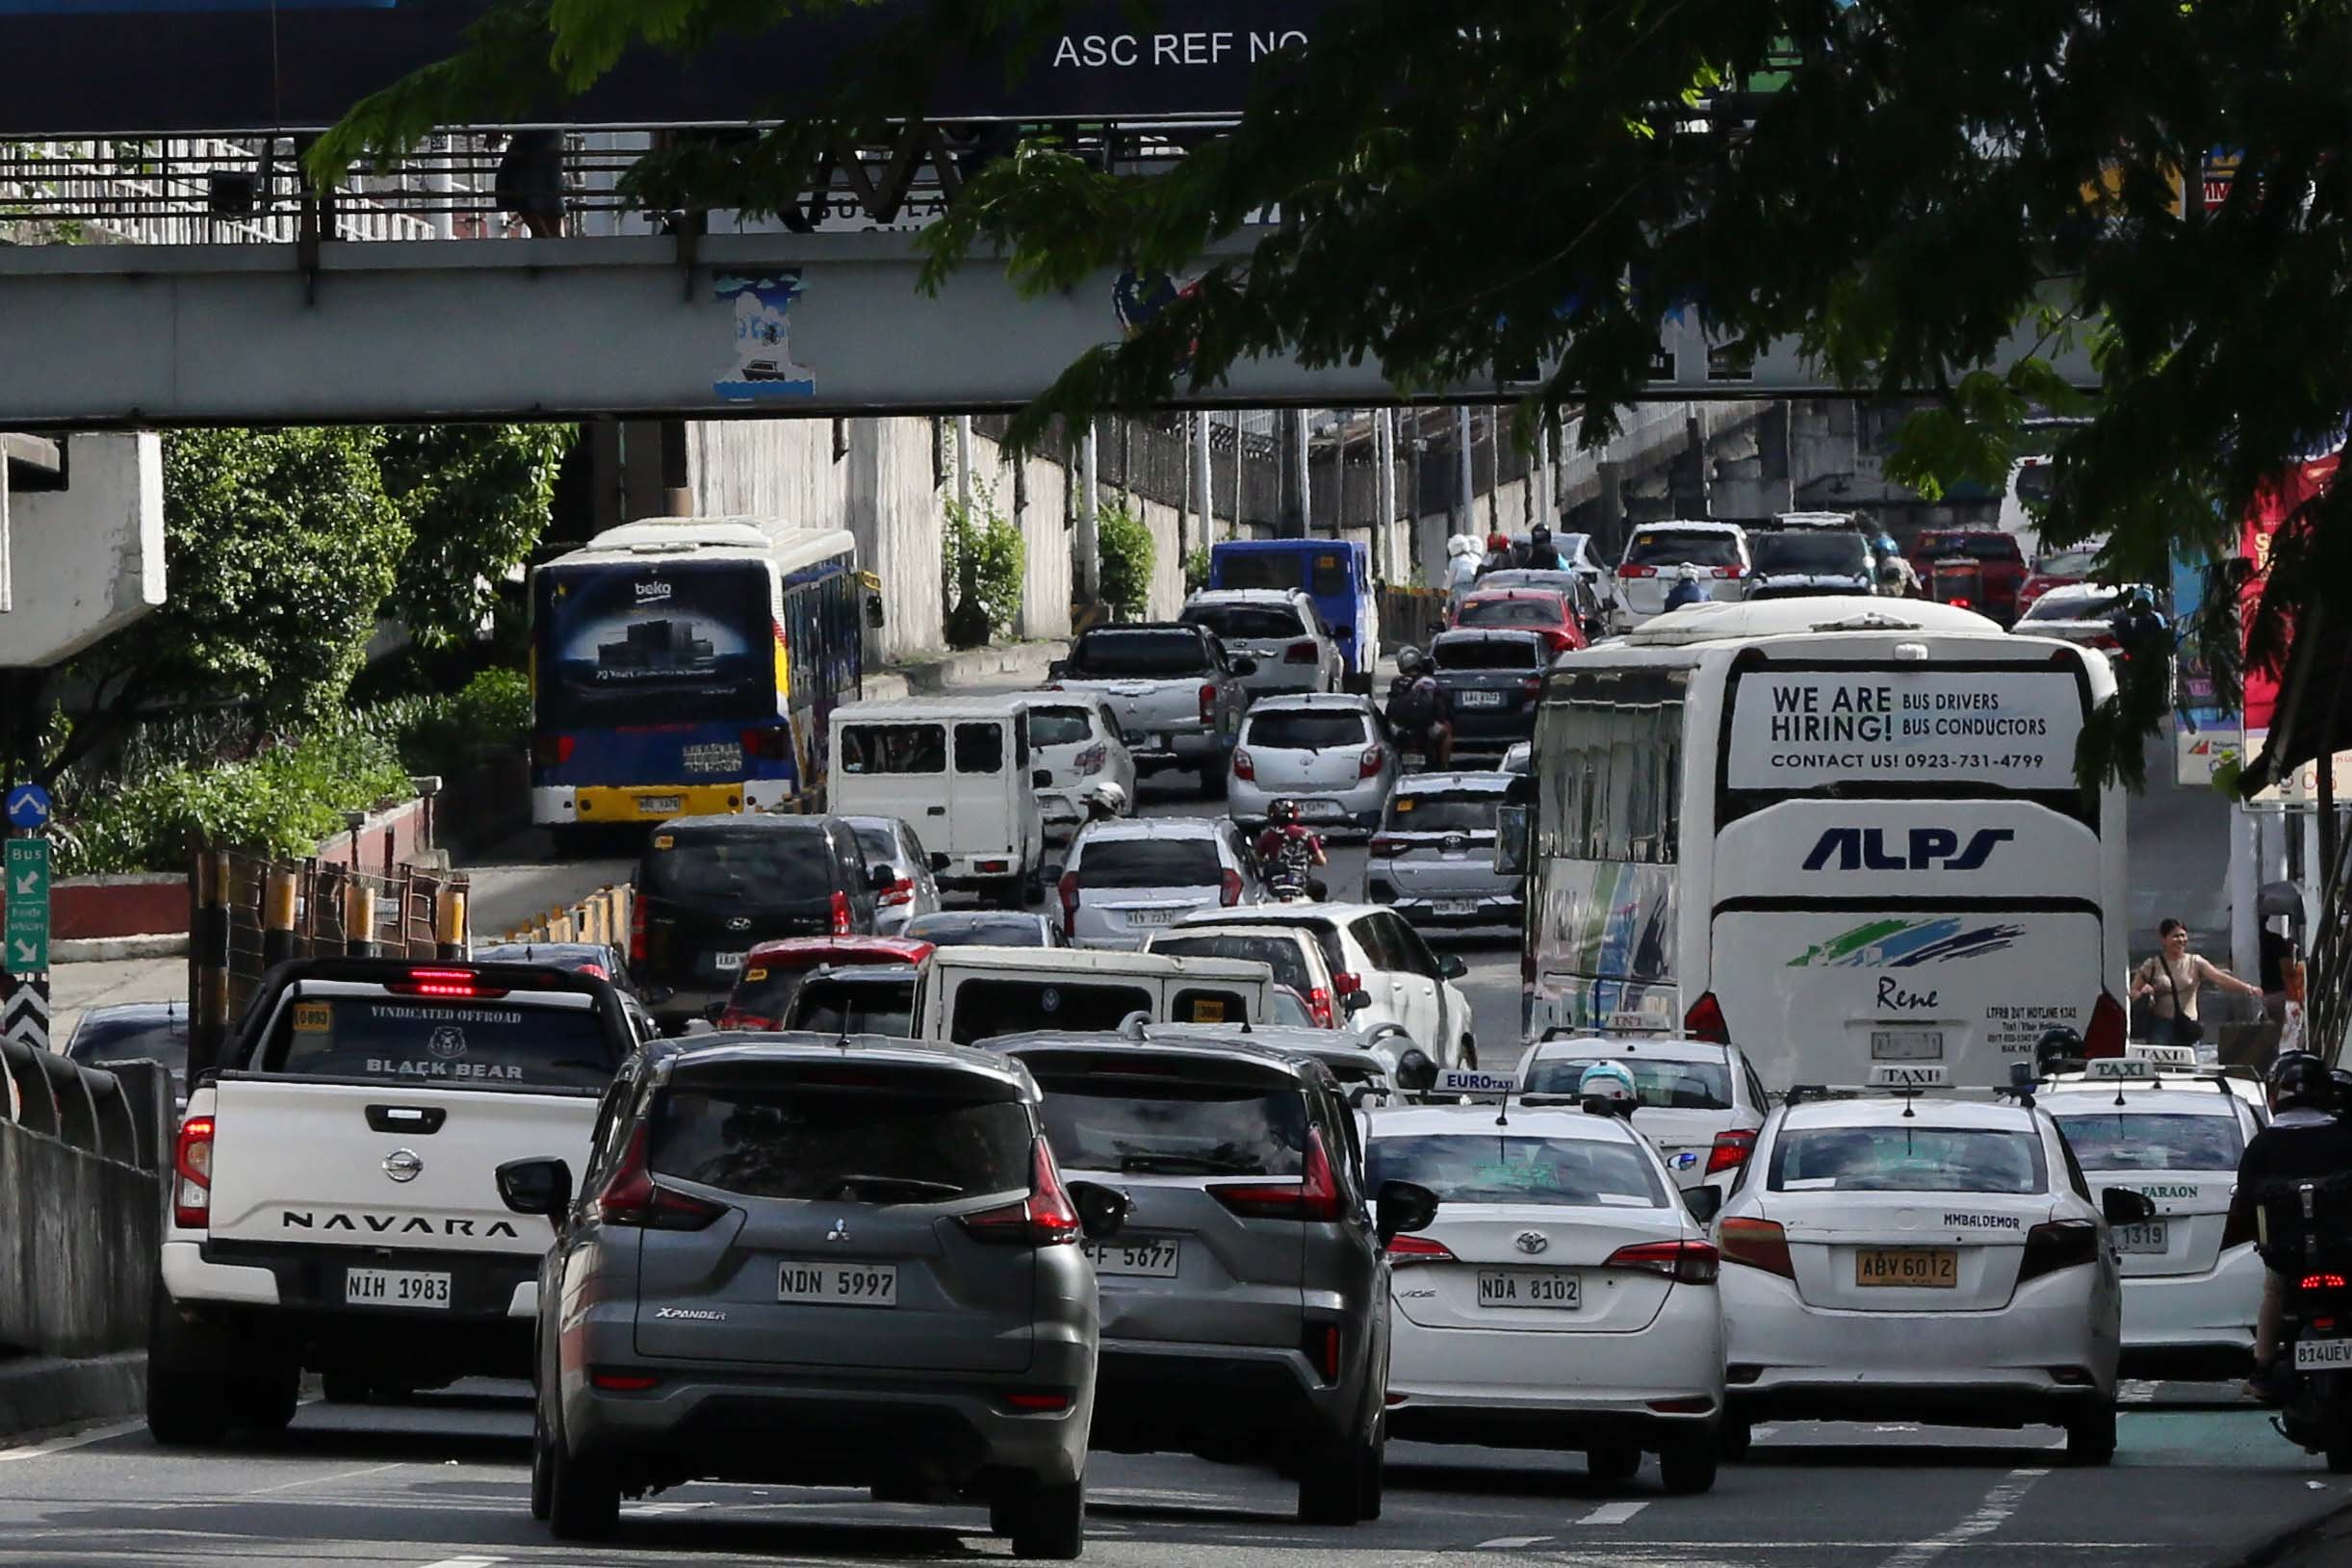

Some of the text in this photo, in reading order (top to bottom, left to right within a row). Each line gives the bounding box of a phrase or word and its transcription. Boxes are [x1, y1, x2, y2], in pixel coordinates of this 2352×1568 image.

[1053, 35, 1138, 67] ASC
[1154, 32, 1233, 65] REF
[634, 580, 671, 595] beko
[1772, 686, 1891, 712] WE ARE
[1902, 693, 1999, 710] BUS DRIVERS
[1771, 715, 1892, 741] HIRING!
[1902, 718, 2047, 735] BUS CONDUCTORS
[1771, 754, 2044, 768] CONTACT US! 0923-731-4799
[13, 848, 42, 861] Bus
[1801, 828, 2015, 870] ALPS
[1877, 976, 1939, 1010] Rene
[371, 1006, 522, 1024] VINDICATED OFFROAD
[2138, 1048, 2180, 1061] TAXI
[366, 1059, 523, 1079] BLACK BEAR
[1883, 1069, 1933, 1082] TAXI
[2096, 1063, 2145, 1075] TAXI
[2140, 1185, 2198, 1198] FARAON
[283, 1211, 519, 1238] NAVARA
[2124, 1225, 2162, 1244] 1319
[1124, 1246, 1176, 1269] 5677
[1863, 1257, 1952, 1278] ABV 6012
[349, 1275, 448, 1300] NIH 1983
[780, 1270, 893, 1297] NDN 5997
[1483, 1278, 1577, 1300] NDA 8102
[656, 1307, 727, 1321] XPANDER
